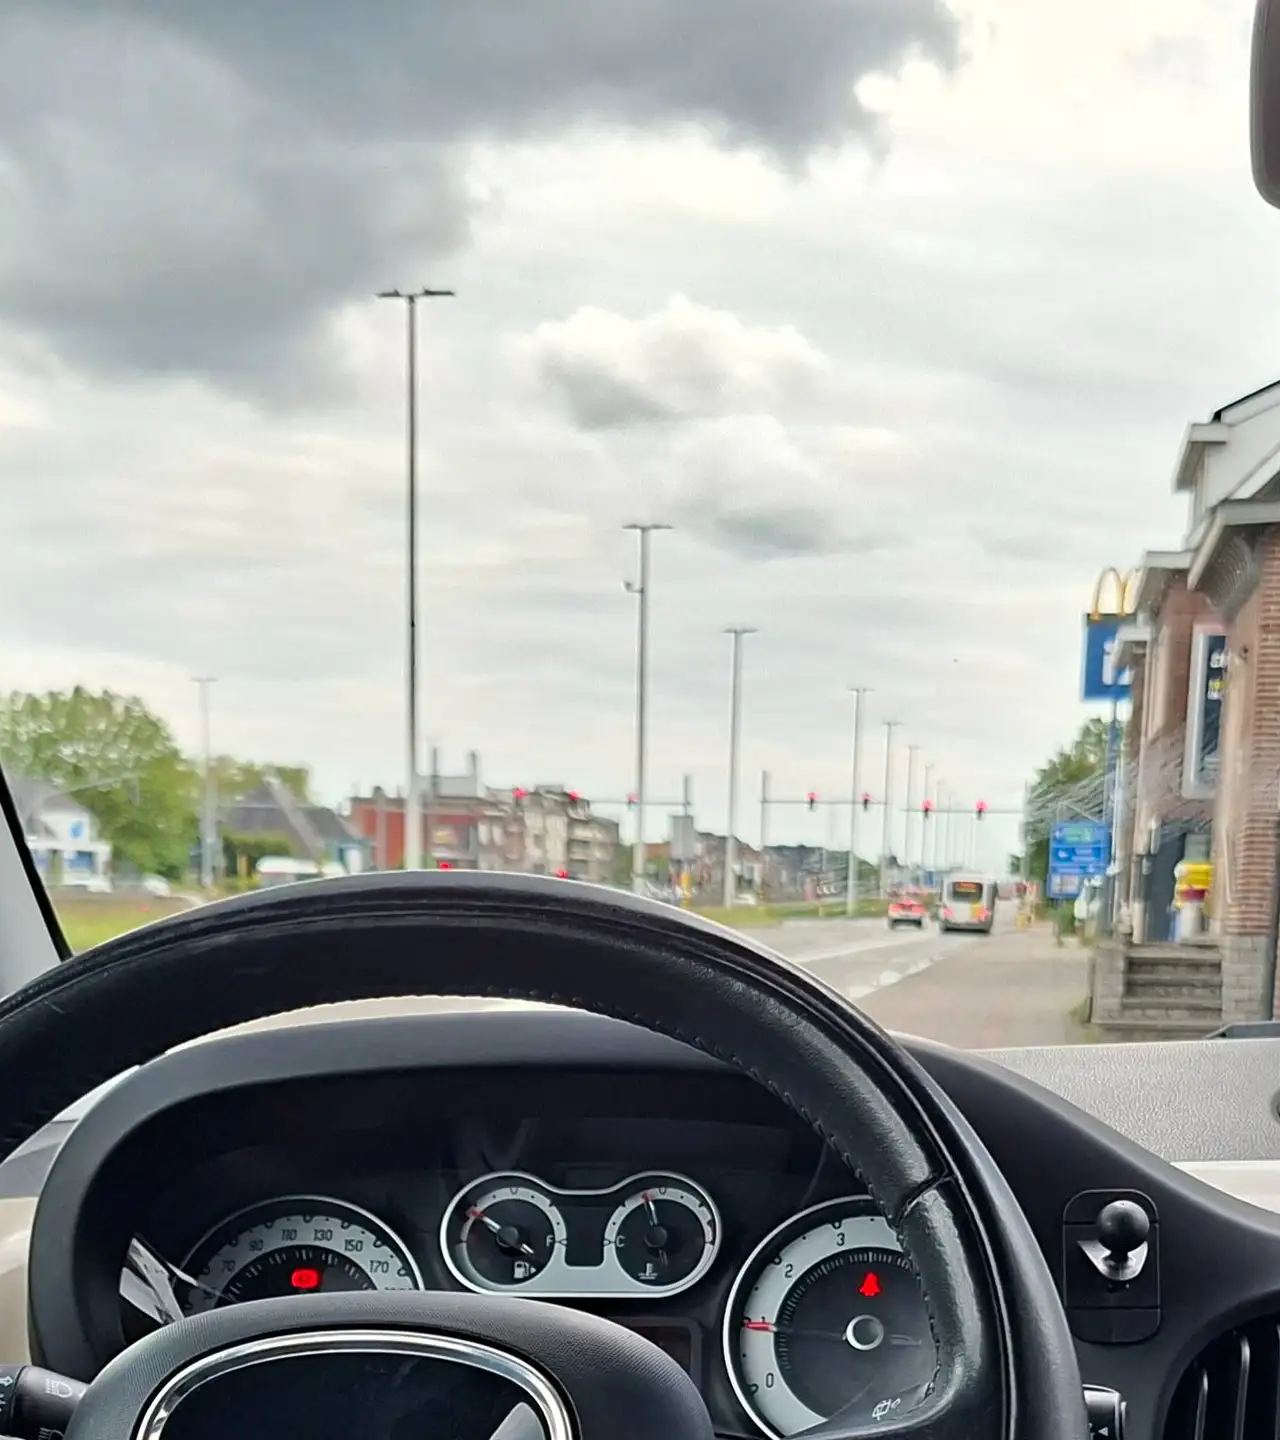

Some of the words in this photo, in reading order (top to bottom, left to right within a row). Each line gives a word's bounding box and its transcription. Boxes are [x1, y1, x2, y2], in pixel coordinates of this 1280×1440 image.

[281, 1228, 298, 1241] 110
[312, 1229, 333, 1242] 130
[836, 1232, 846, 1246] 3
[343, 1239, 364, 1252] 150
[545, 1235, 554, 1248] F
[615, 1235, 625, 1248] C
[369, 1260, 390, 1274] 170
[784, 1263, 794, 1278] 2
[765, 1372, 775, 1388] 0
